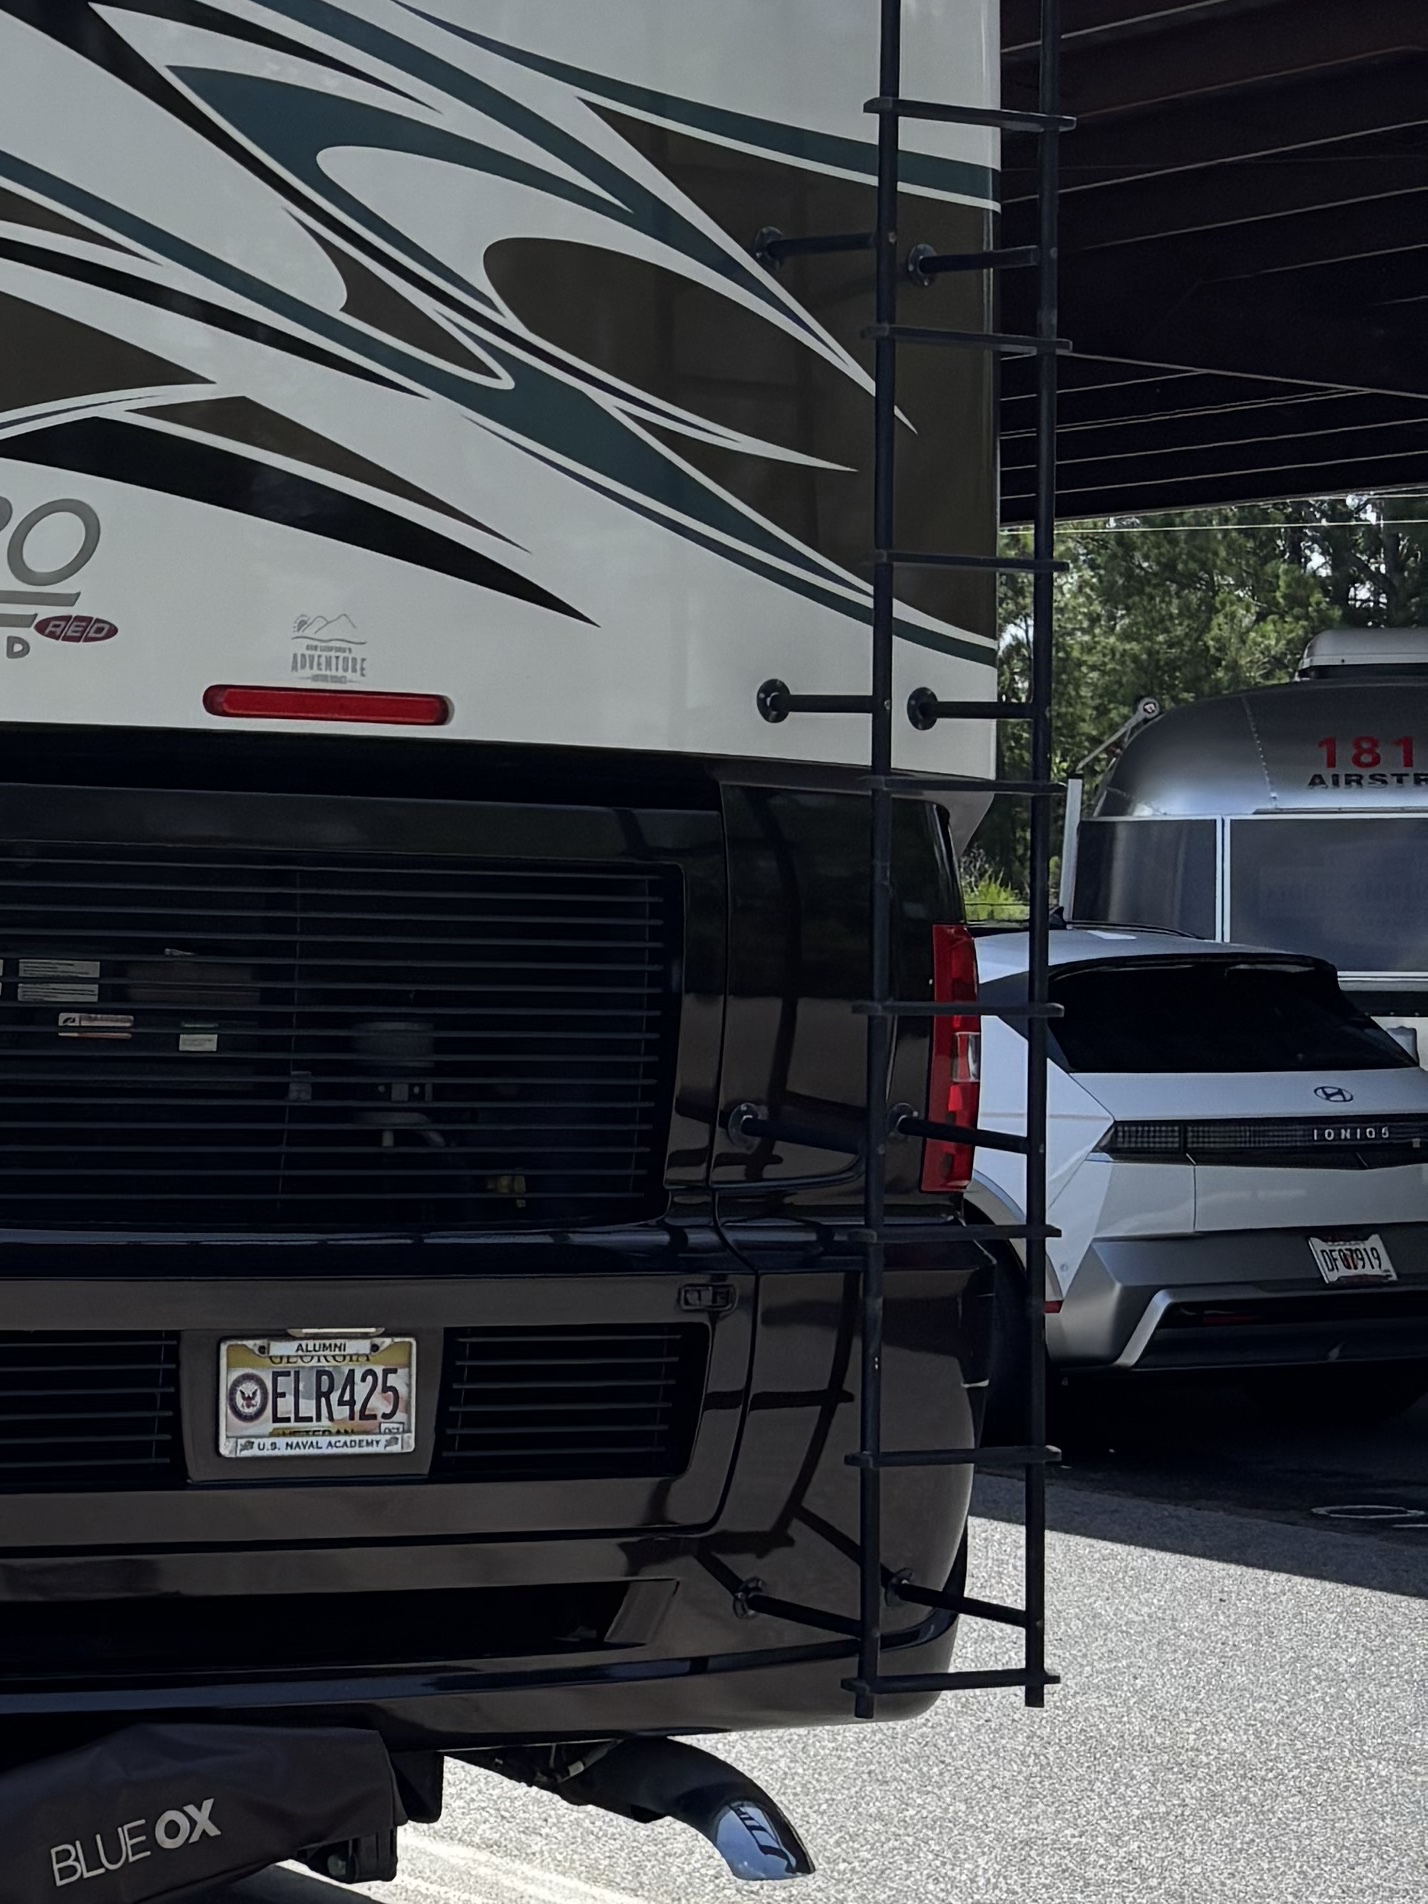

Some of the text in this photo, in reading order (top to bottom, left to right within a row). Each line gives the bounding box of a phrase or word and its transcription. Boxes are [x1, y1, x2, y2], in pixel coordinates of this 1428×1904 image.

[291, 652, 367, 677] ADVENTURE
[295, 1342, 347, 1353] ALUMNI
[271, 1367, 400, 1424] ELR425
[285, 1441, 323, 1451] NAVAL
[325, 1439, 382, 1450] ACADEMY
[50, 1798, 222, 1887] BLUE OX
